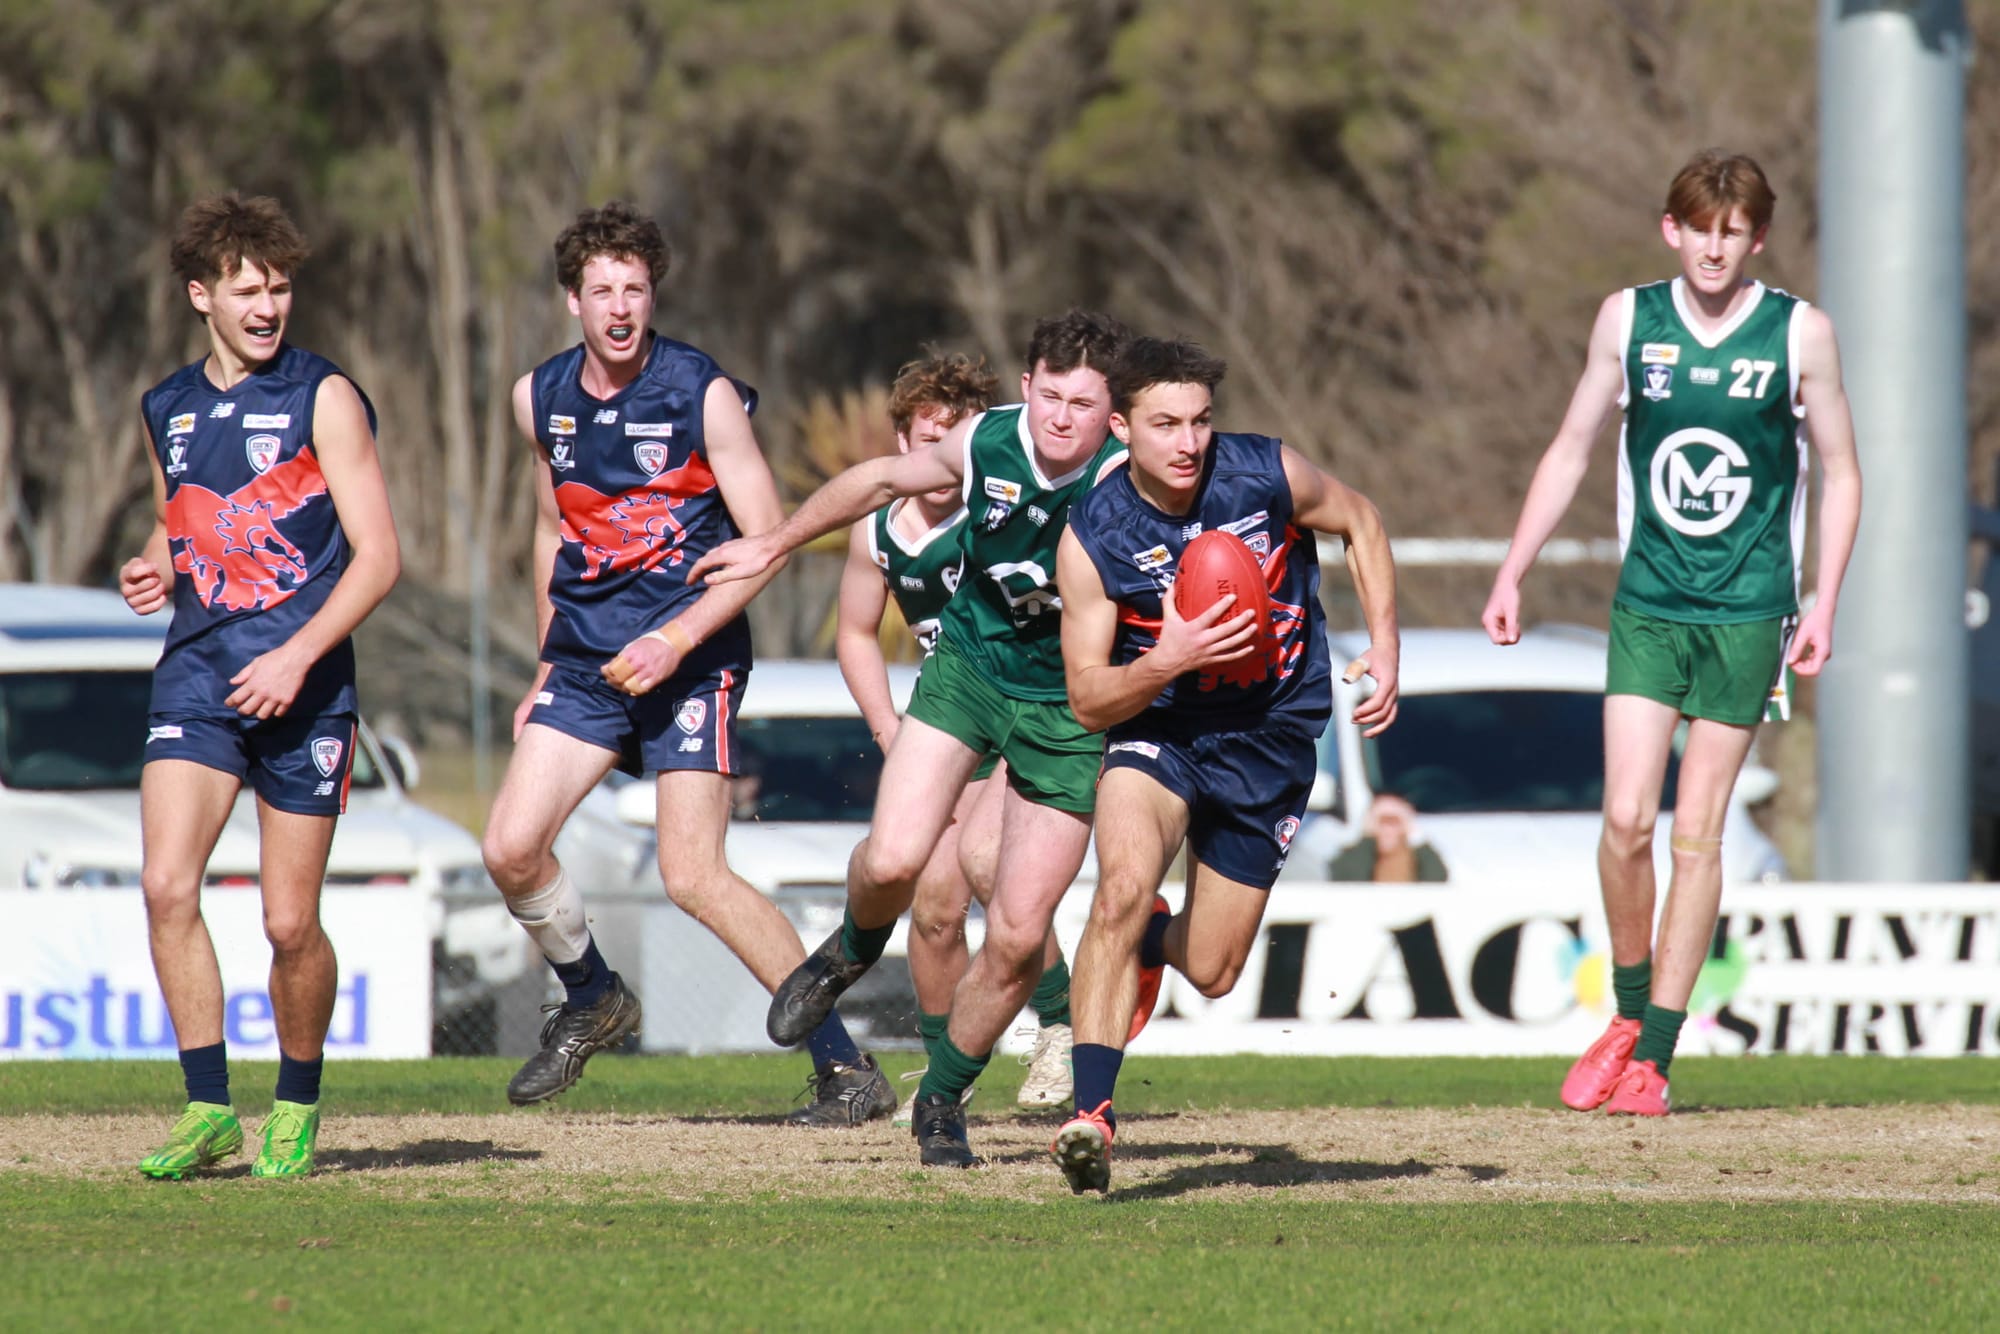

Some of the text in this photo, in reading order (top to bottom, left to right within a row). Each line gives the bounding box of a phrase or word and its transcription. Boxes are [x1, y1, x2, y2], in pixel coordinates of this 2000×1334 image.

[1728, 358, 1777, 399] 27
[1683, 498, 1710, 511] FNL
[1711, 1000, 2000, 1052] SERVI
